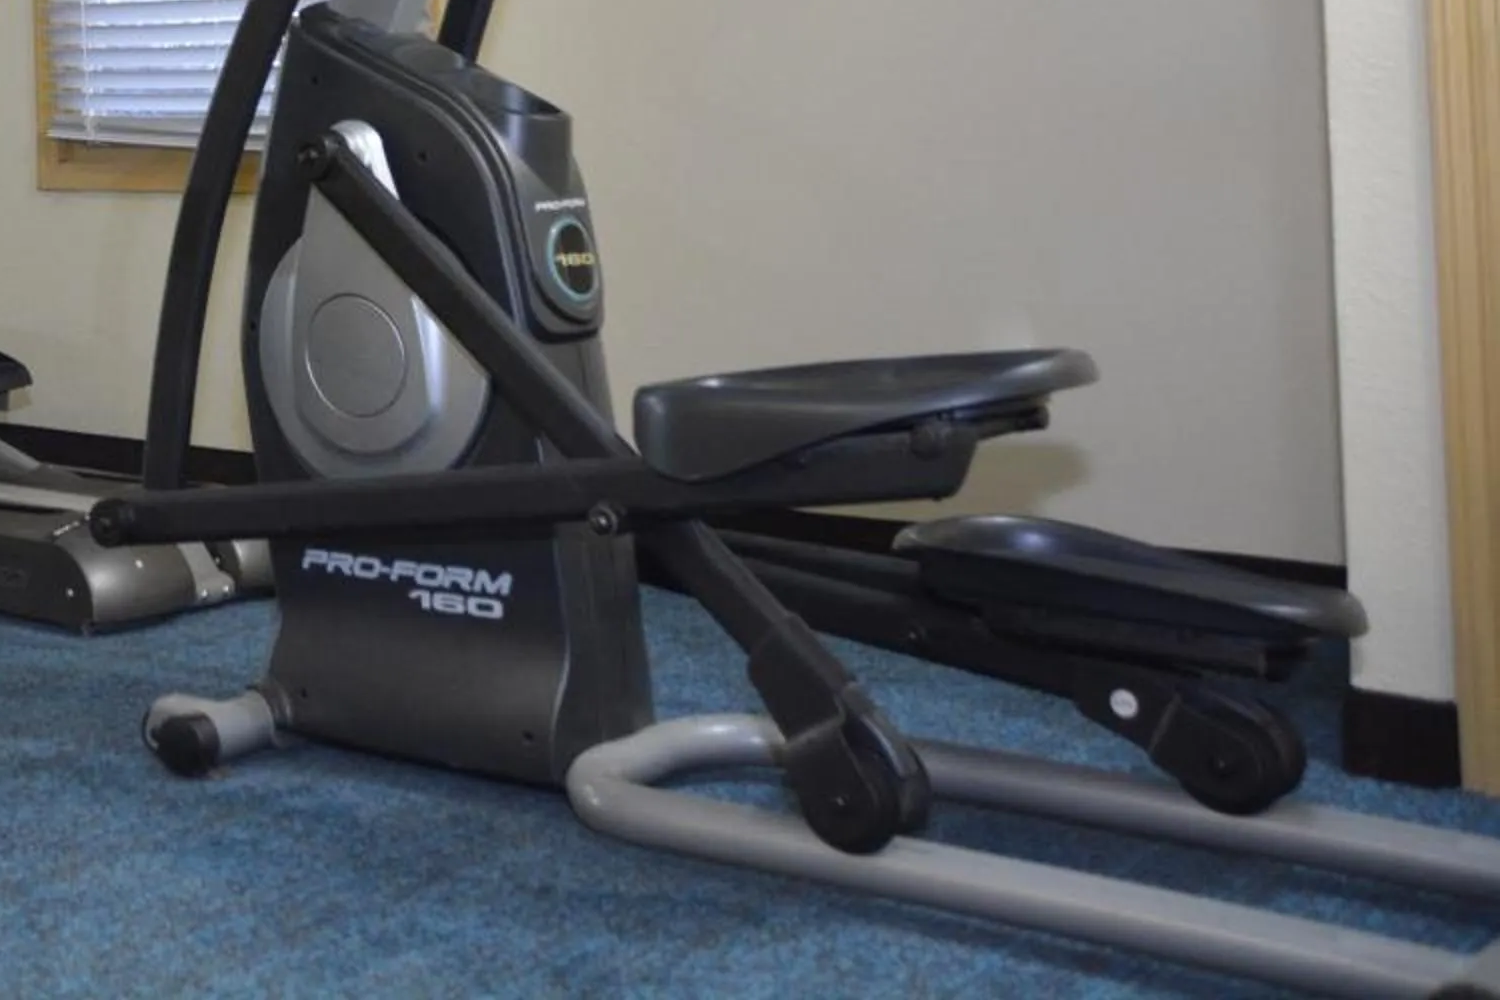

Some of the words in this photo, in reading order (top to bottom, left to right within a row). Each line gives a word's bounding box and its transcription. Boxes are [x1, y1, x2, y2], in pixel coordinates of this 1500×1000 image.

[555, 252, 596, 267] 160
[302, 548, 513, 597] PRO-FORM
[408, 589, 504, 619] 160
